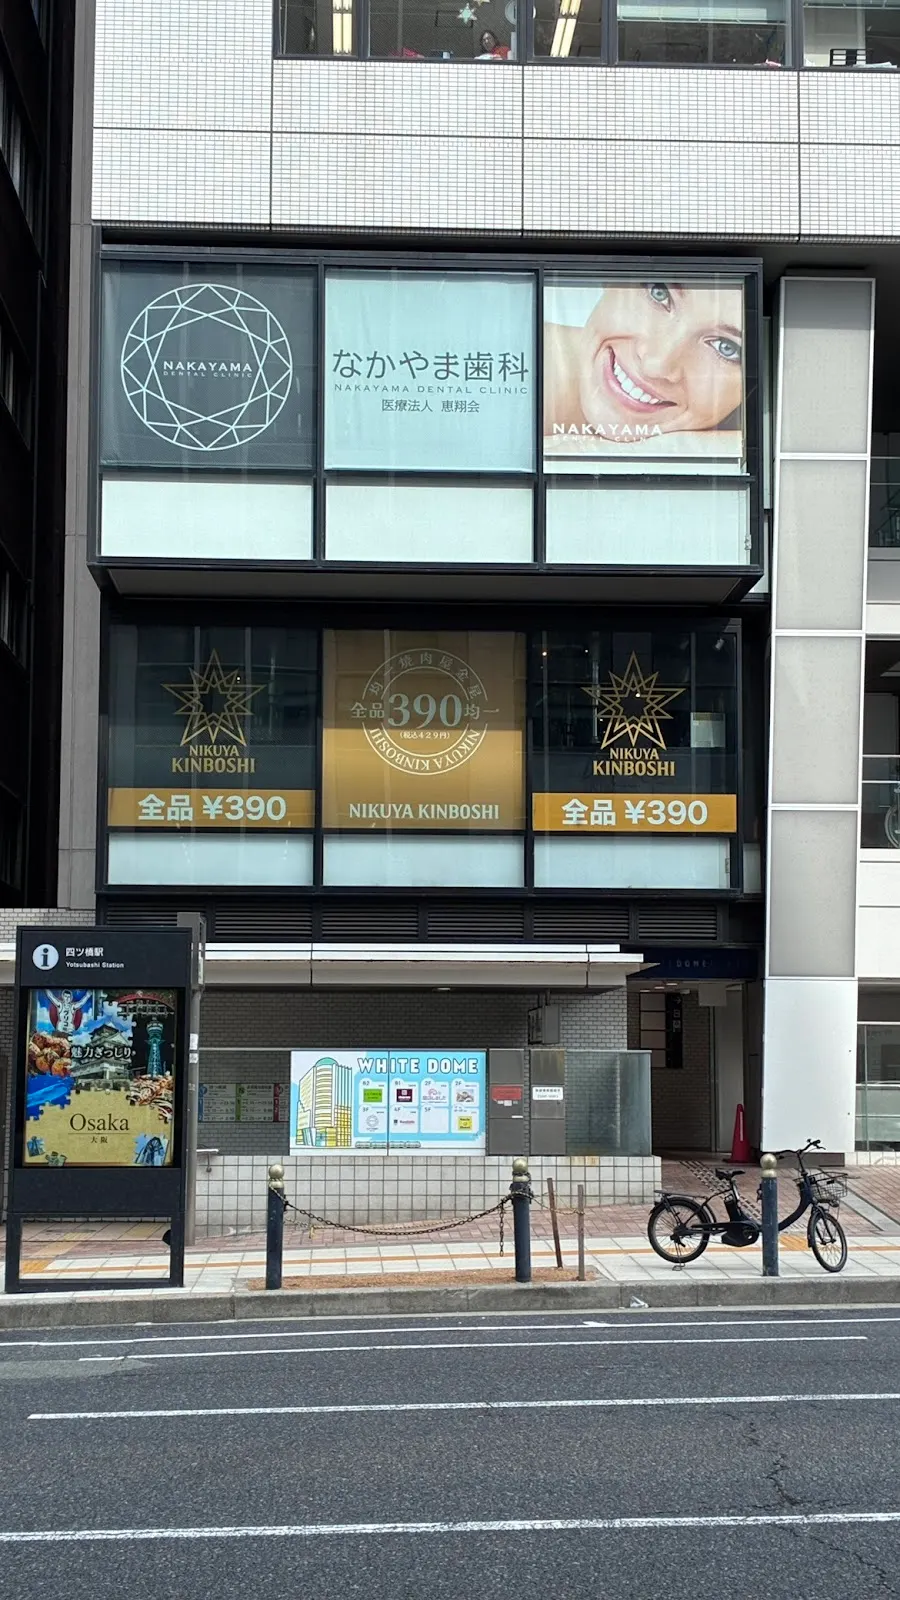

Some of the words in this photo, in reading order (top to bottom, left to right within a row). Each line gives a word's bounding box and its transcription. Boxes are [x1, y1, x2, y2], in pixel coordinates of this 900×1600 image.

[163, 361, 252, 372] NAKAYAMA
[332, 349, 529, 383] なかやま歯科
[334, 384, 410, 393] NAKAYAMA
[417, 385, 472, 394] DENTAL
[479, 386, 528, 395] CLINIC
[381, 399, 433, 413] 医療法人
[441, 399, 480, 413] 恵翔会
[552, 423, 663, 436] NAKAYAMA
[189, 745, 240, 757] NIKUYA
[369, 728, 430, 771] KINBOSHI
[432, 729, 480, 769] NIKUYA
[609, 748, 660, 760] NIKUYA
[171, 758, 255, 773] KINBOSHI
[593, 761, 675, 776] KINBOSHI
[138, 793, 193, 821] 全品
[202, 795, 286, 821] ¥390
[349, 803, 414, 819] NIKUYA
[418, 804, 499, 820] KINBOSHI
[561, 798, 616, 826] 全品
[624, 800, 708, 825] ¥390
[65, 947, 104, 957] 四ツ橋駅
[71, 1046, 132, 1058] 魅力ぎっしり
[357, 1057, 420, 1074] WHITE
[426, 1058, 479, 1074] DOME
[69, 1113, 130, 1131] Osaka
[90, 1136, 108, 1144] 大阪
